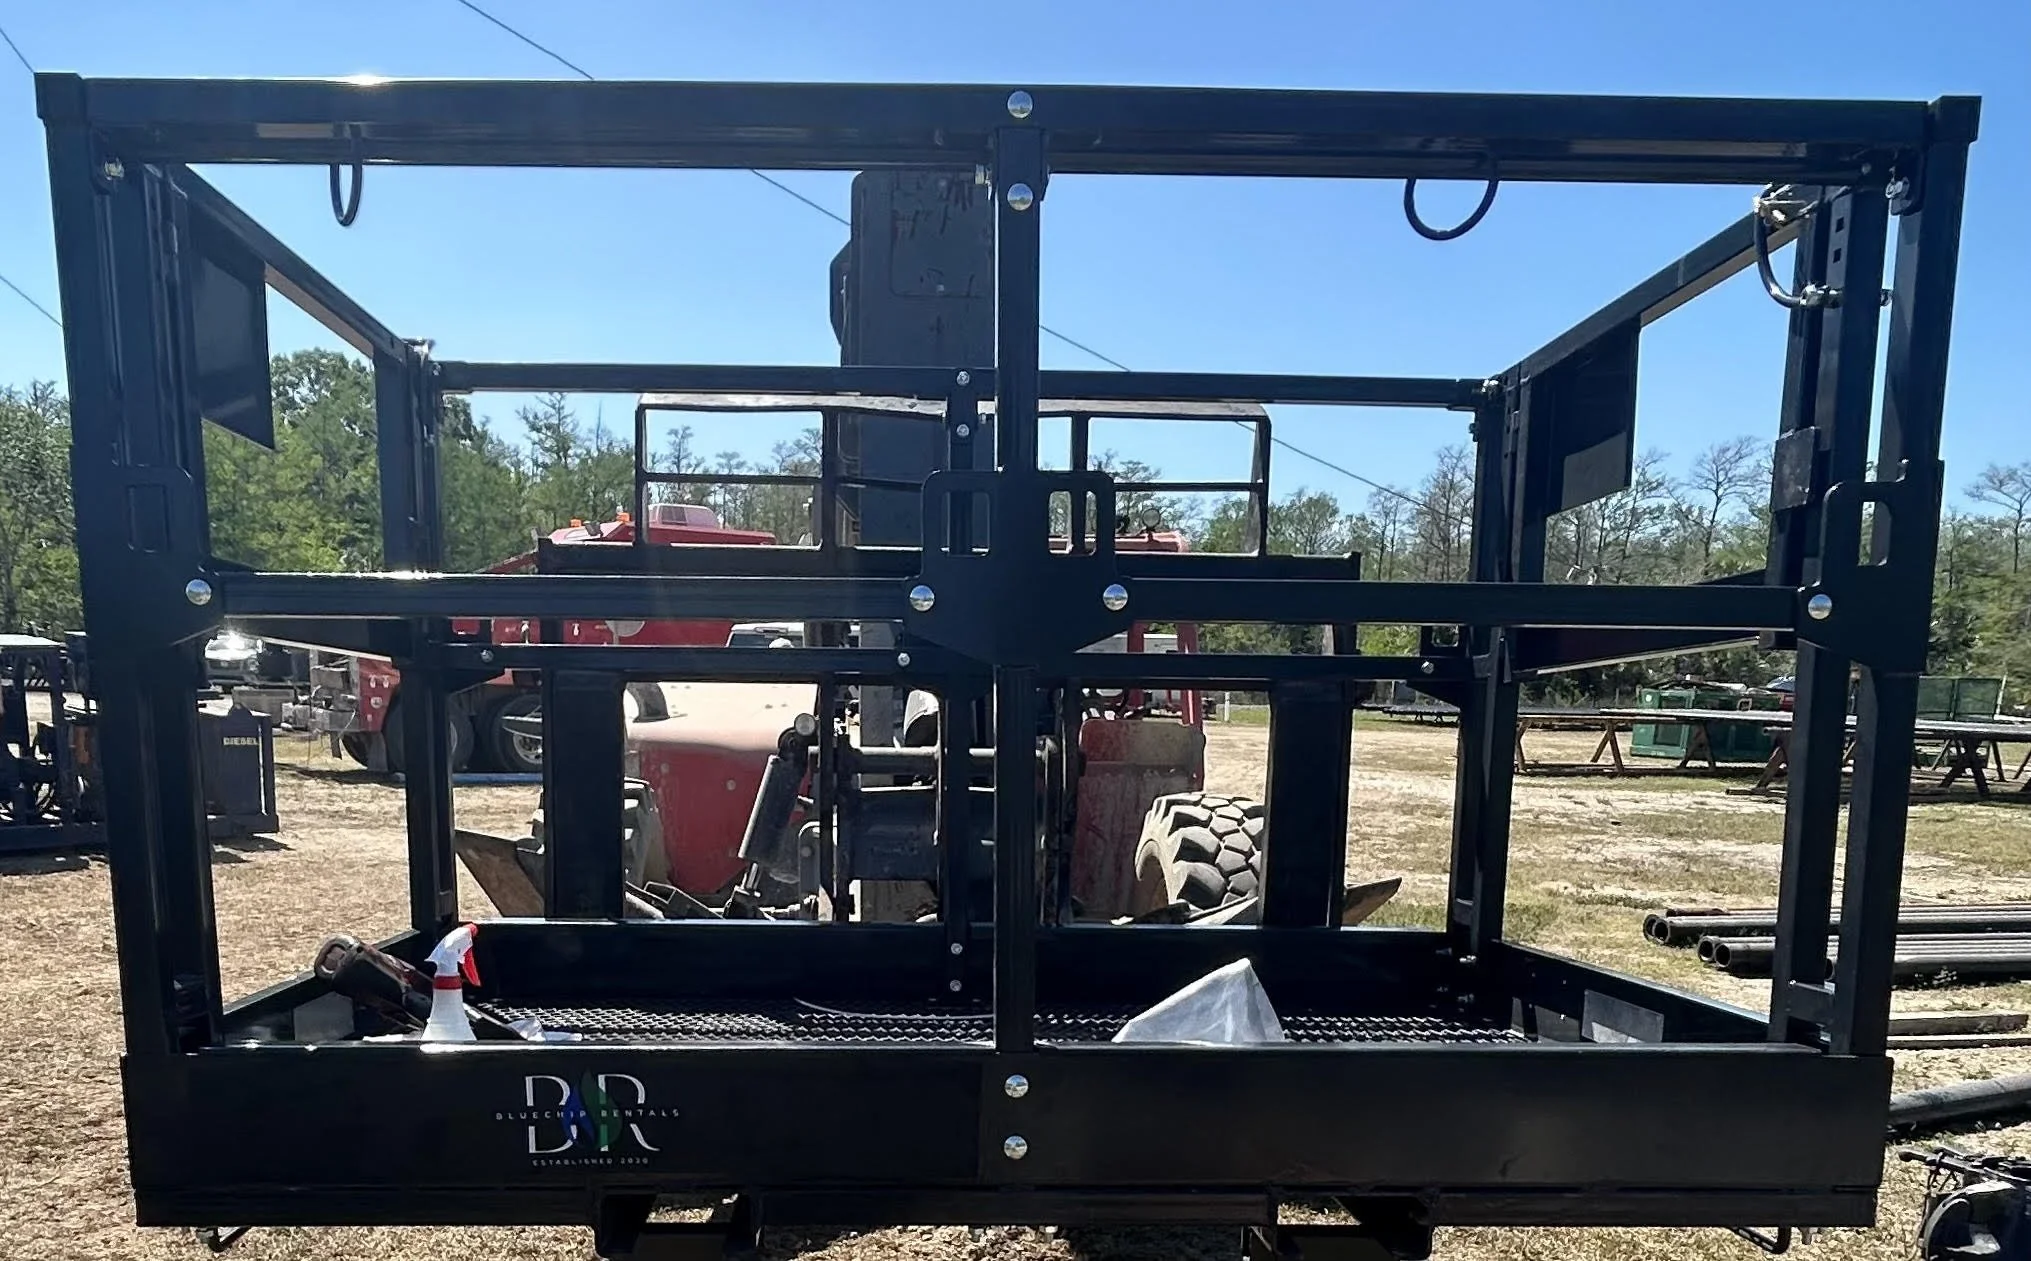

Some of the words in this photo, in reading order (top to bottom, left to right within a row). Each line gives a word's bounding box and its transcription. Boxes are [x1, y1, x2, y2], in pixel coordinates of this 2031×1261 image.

[223, 737, 258, 746] DIESEL
[495, 1110, 587, 1121] BLUECHIP
[600, 1108, 680, 1118] RENTALS
[532, 1157, 613, 1167] ESTABLISHED
